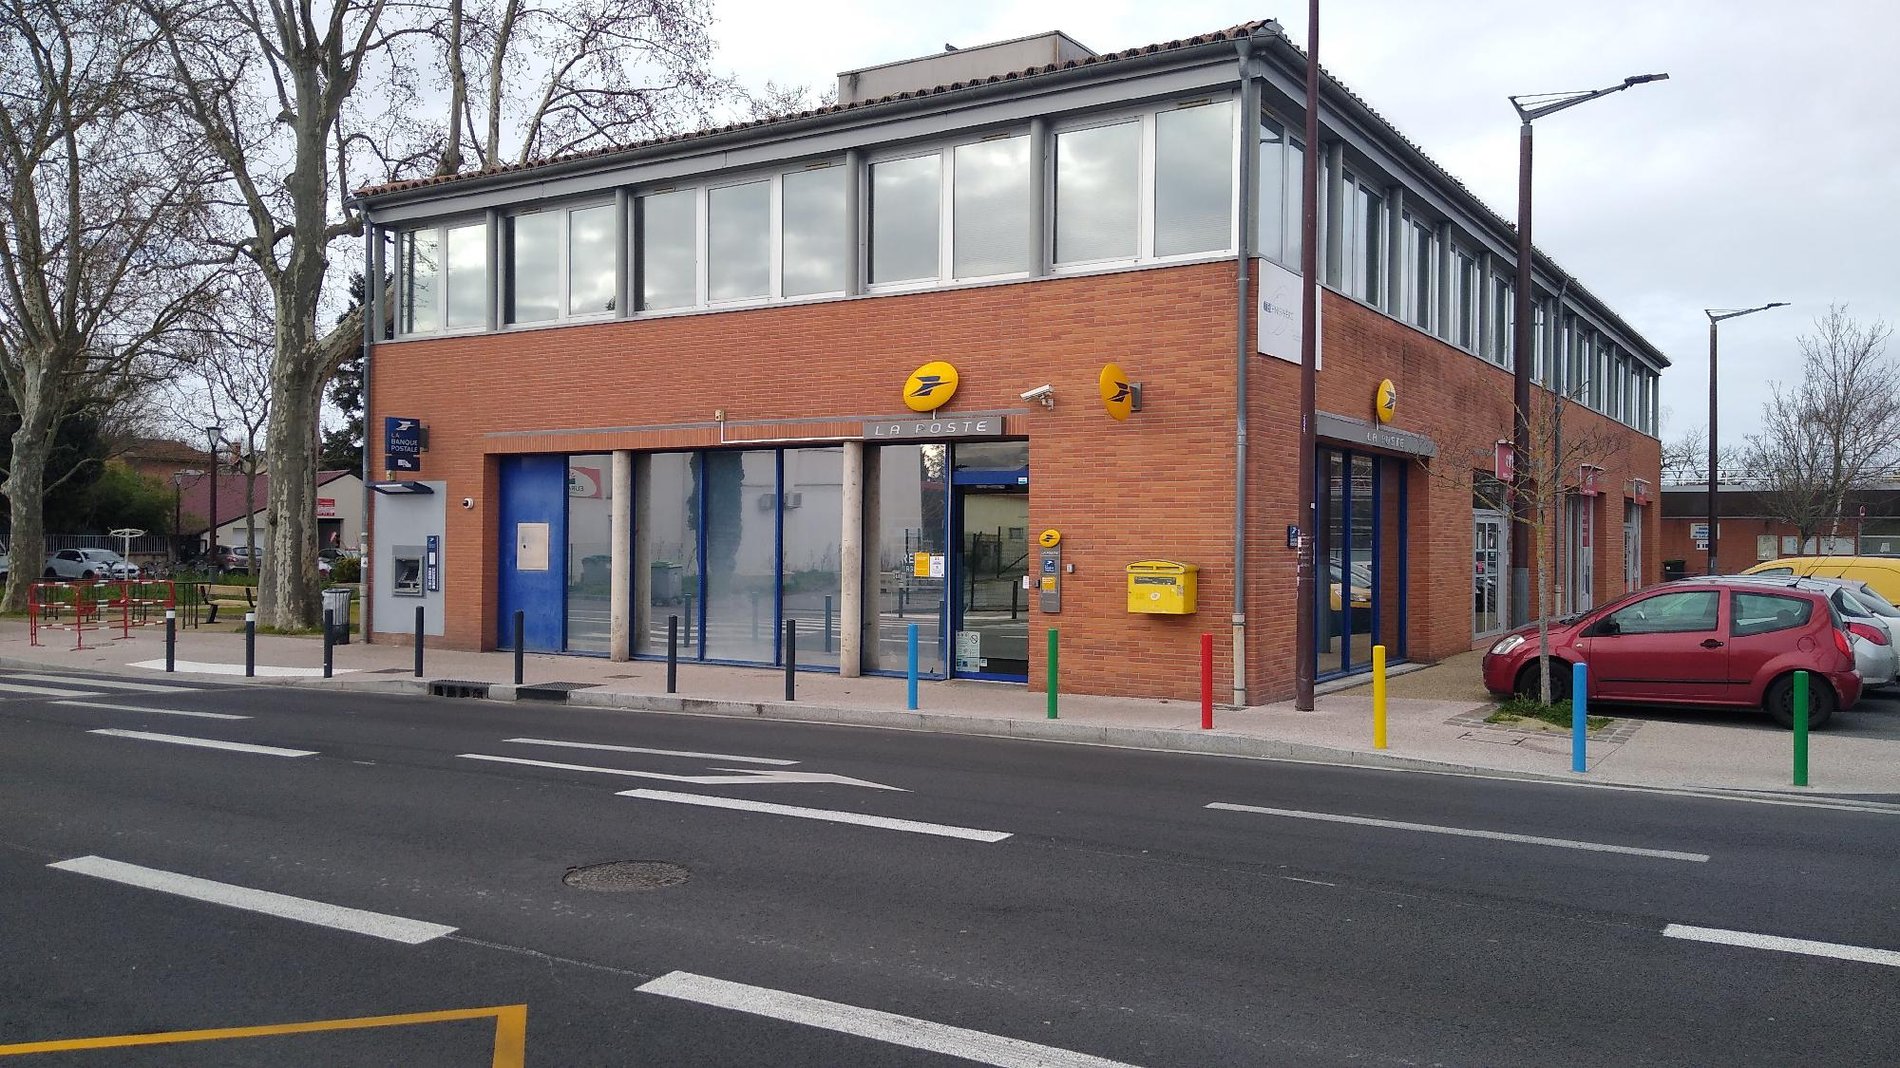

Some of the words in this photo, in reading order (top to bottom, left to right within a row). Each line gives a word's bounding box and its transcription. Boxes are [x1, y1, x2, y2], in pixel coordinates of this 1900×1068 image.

[874, 424, 901, 436] LA
[915, 420, 988, 434] POSTE
[390, 438, 418, 446] BANQUE
[1367, 432, 1378, 443] LA
[1381, 434, 1405, 449] POSTE
[390, 445, 418, 453] POSTALE
